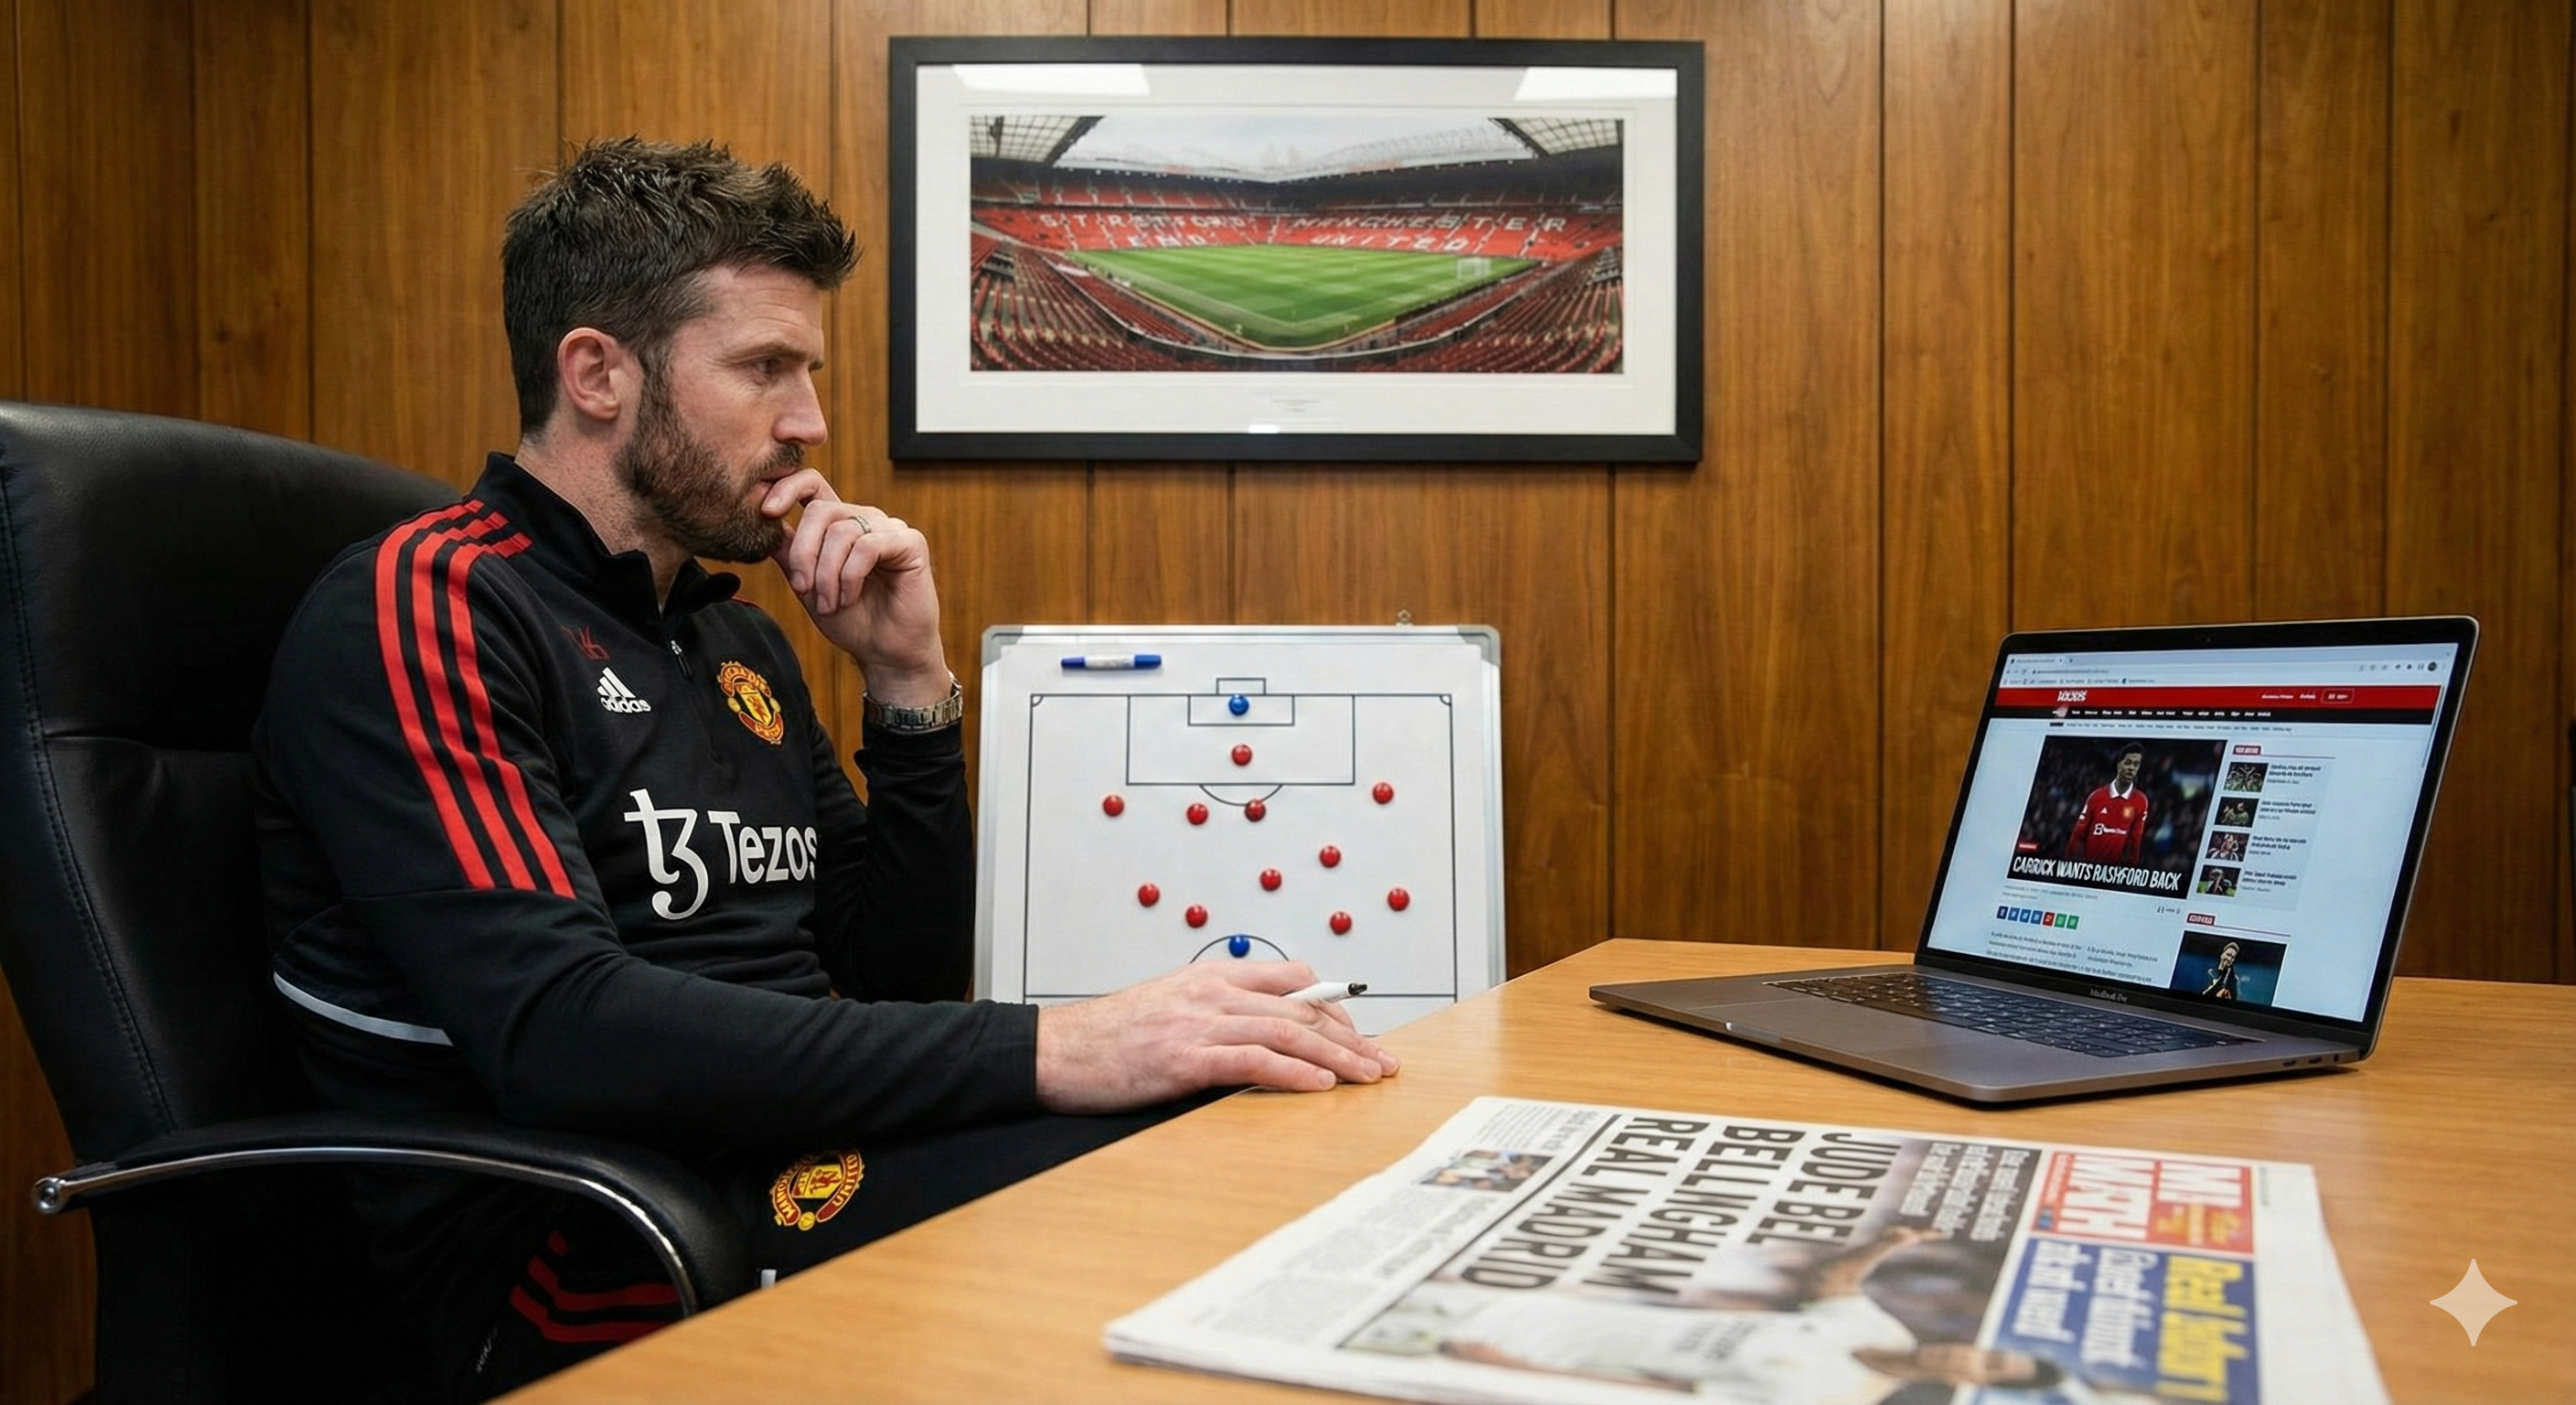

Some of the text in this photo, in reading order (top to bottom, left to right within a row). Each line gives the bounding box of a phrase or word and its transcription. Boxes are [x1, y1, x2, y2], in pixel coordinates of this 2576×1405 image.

[1310, 234, 1469, 252] UNITED
[707, 810, 818, 885] Tezos
[2056, 859, 2094, 881] WANTS
[2092, 863, 2150, 887] RASHFORD
[2149, 870, 2183, 891] BACK
[1582, 1117, 1711, 1176] REAL
[832, 1154, 858, 1207] UNITED
[1745, 1132, 1903, 1245] JUDE BEL
[1461, 1183, 1651, 1289] MADRID
